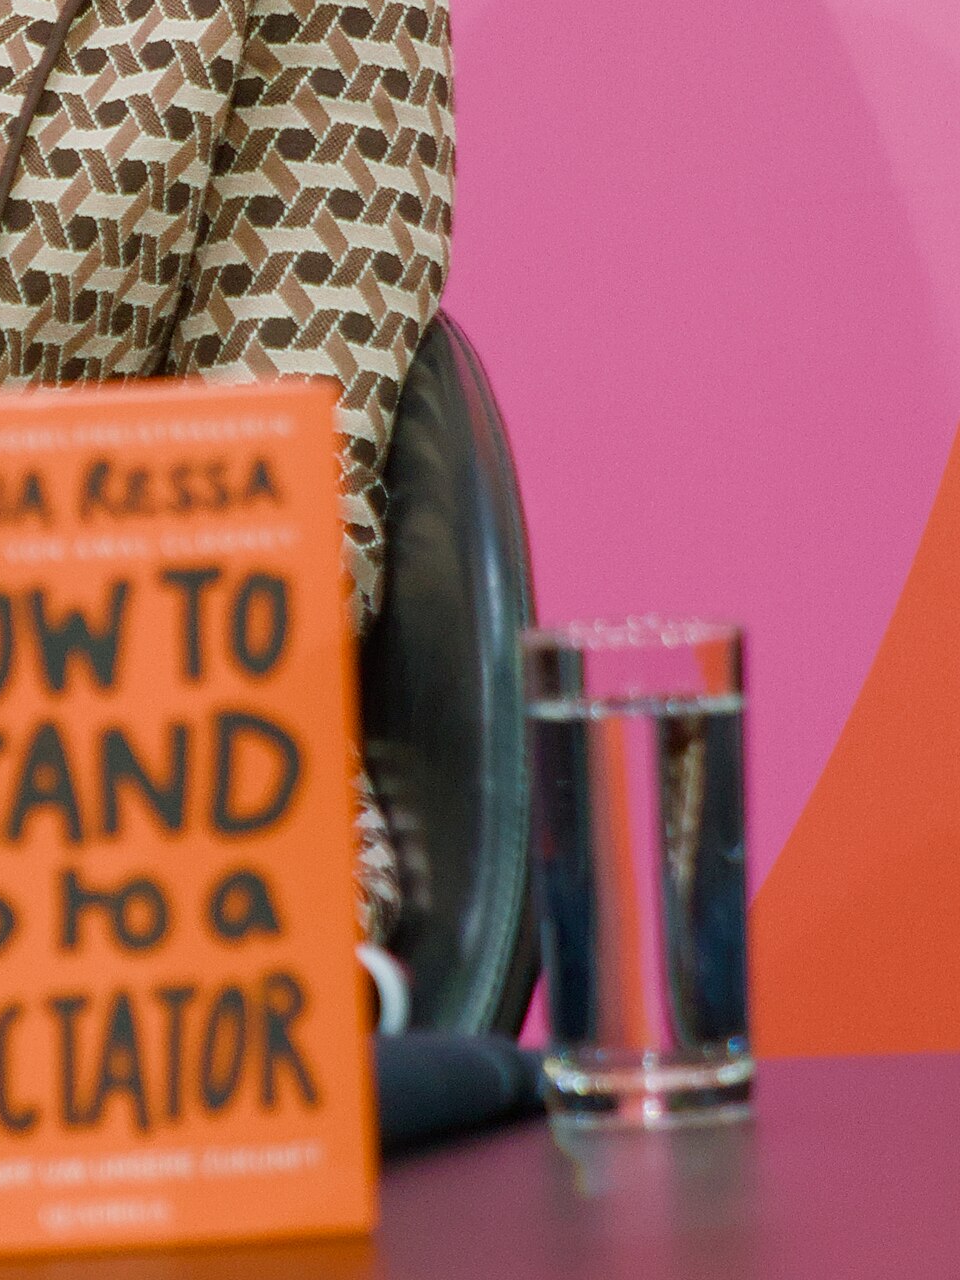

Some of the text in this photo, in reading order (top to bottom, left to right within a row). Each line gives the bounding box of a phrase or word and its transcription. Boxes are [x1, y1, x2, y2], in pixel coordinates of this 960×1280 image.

[157, 563, 294, 686] TO
[57, 865, 174, 955] to
[203, 865, 286, 945] a
